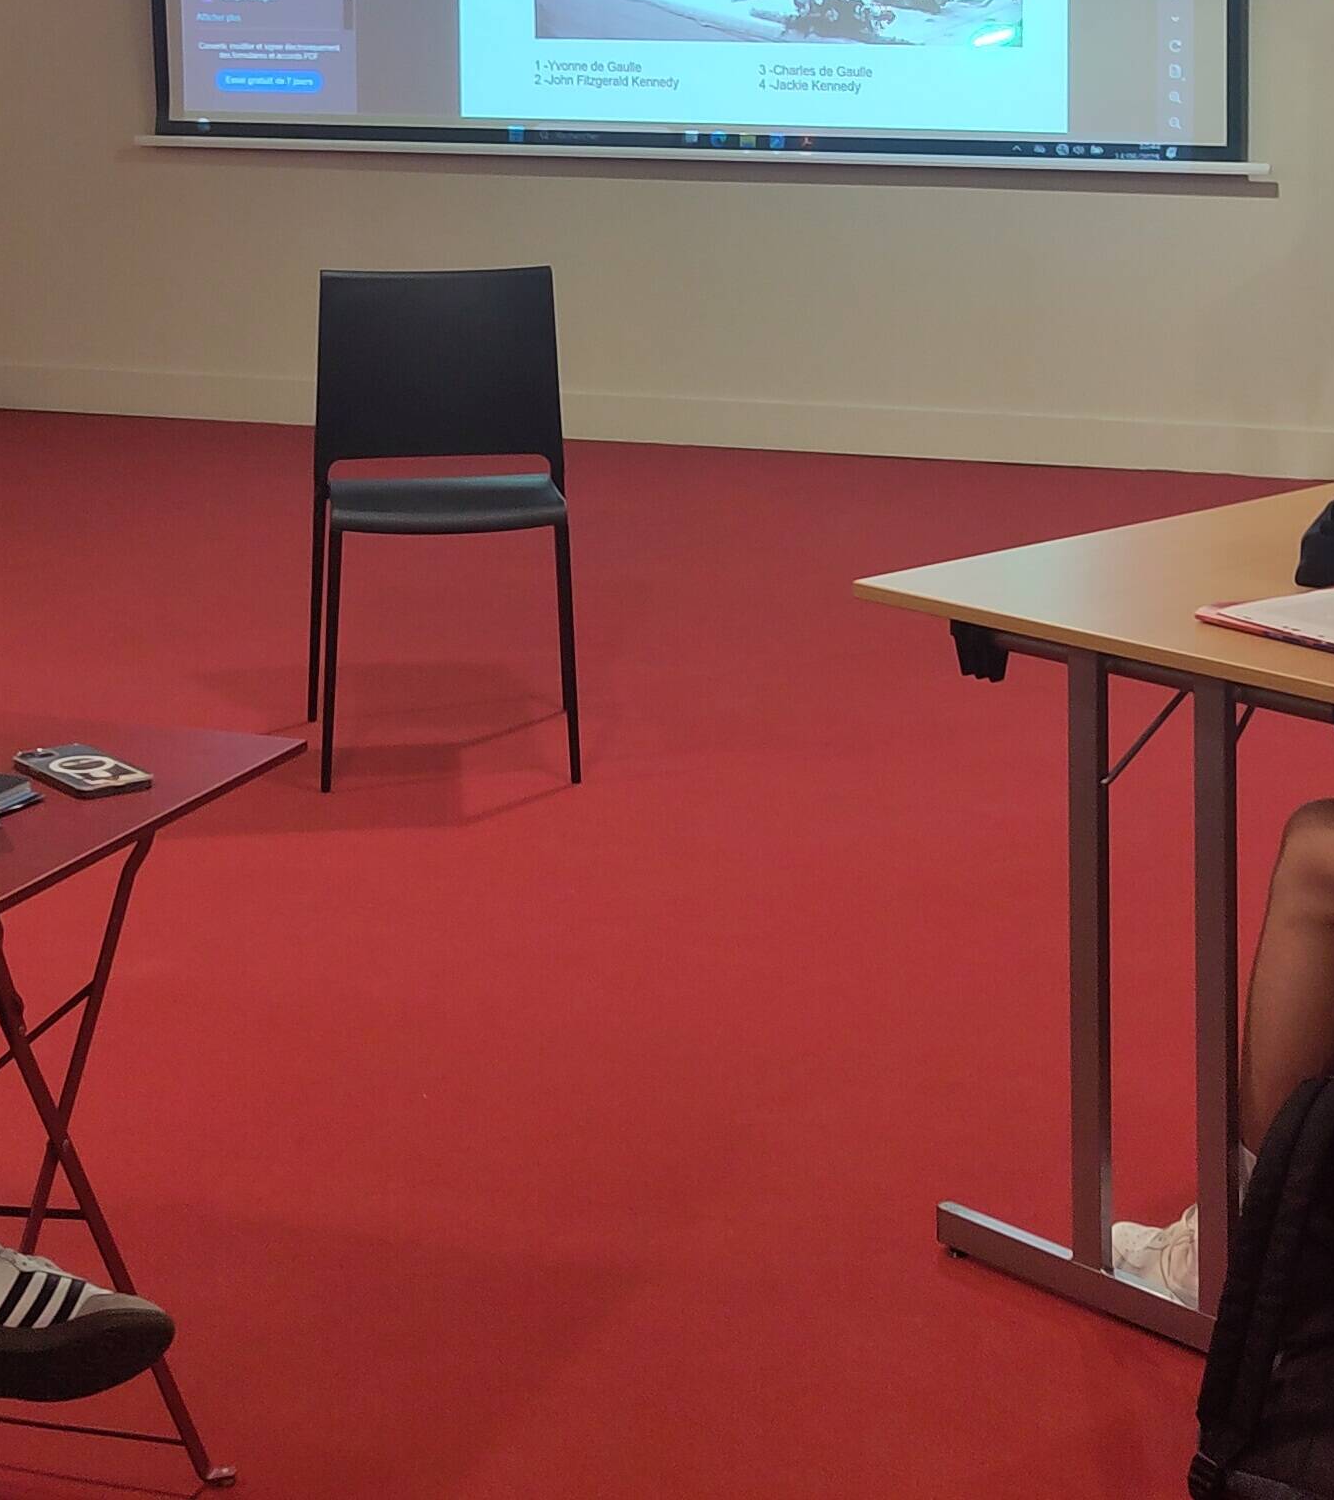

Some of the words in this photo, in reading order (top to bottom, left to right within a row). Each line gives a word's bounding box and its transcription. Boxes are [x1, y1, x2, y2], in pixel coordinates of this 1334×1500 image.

[535, 60, 540, 70] 1
[590, 61, 604, 72] de
[607, 61, 642, 72] Gaulle
[759, 64, 766, 75] 3
[819, 66, 833, 76] de
[836, 66, 872, 77] Gaulle
[534, 74, 541, 85] 2
[577, 75, 628, 88] Fitzgerald
[632, 76, 679, 90] Kennedy
[759, 79, 766, 89] 4
[812, 80, 861, 95] Kennedy
